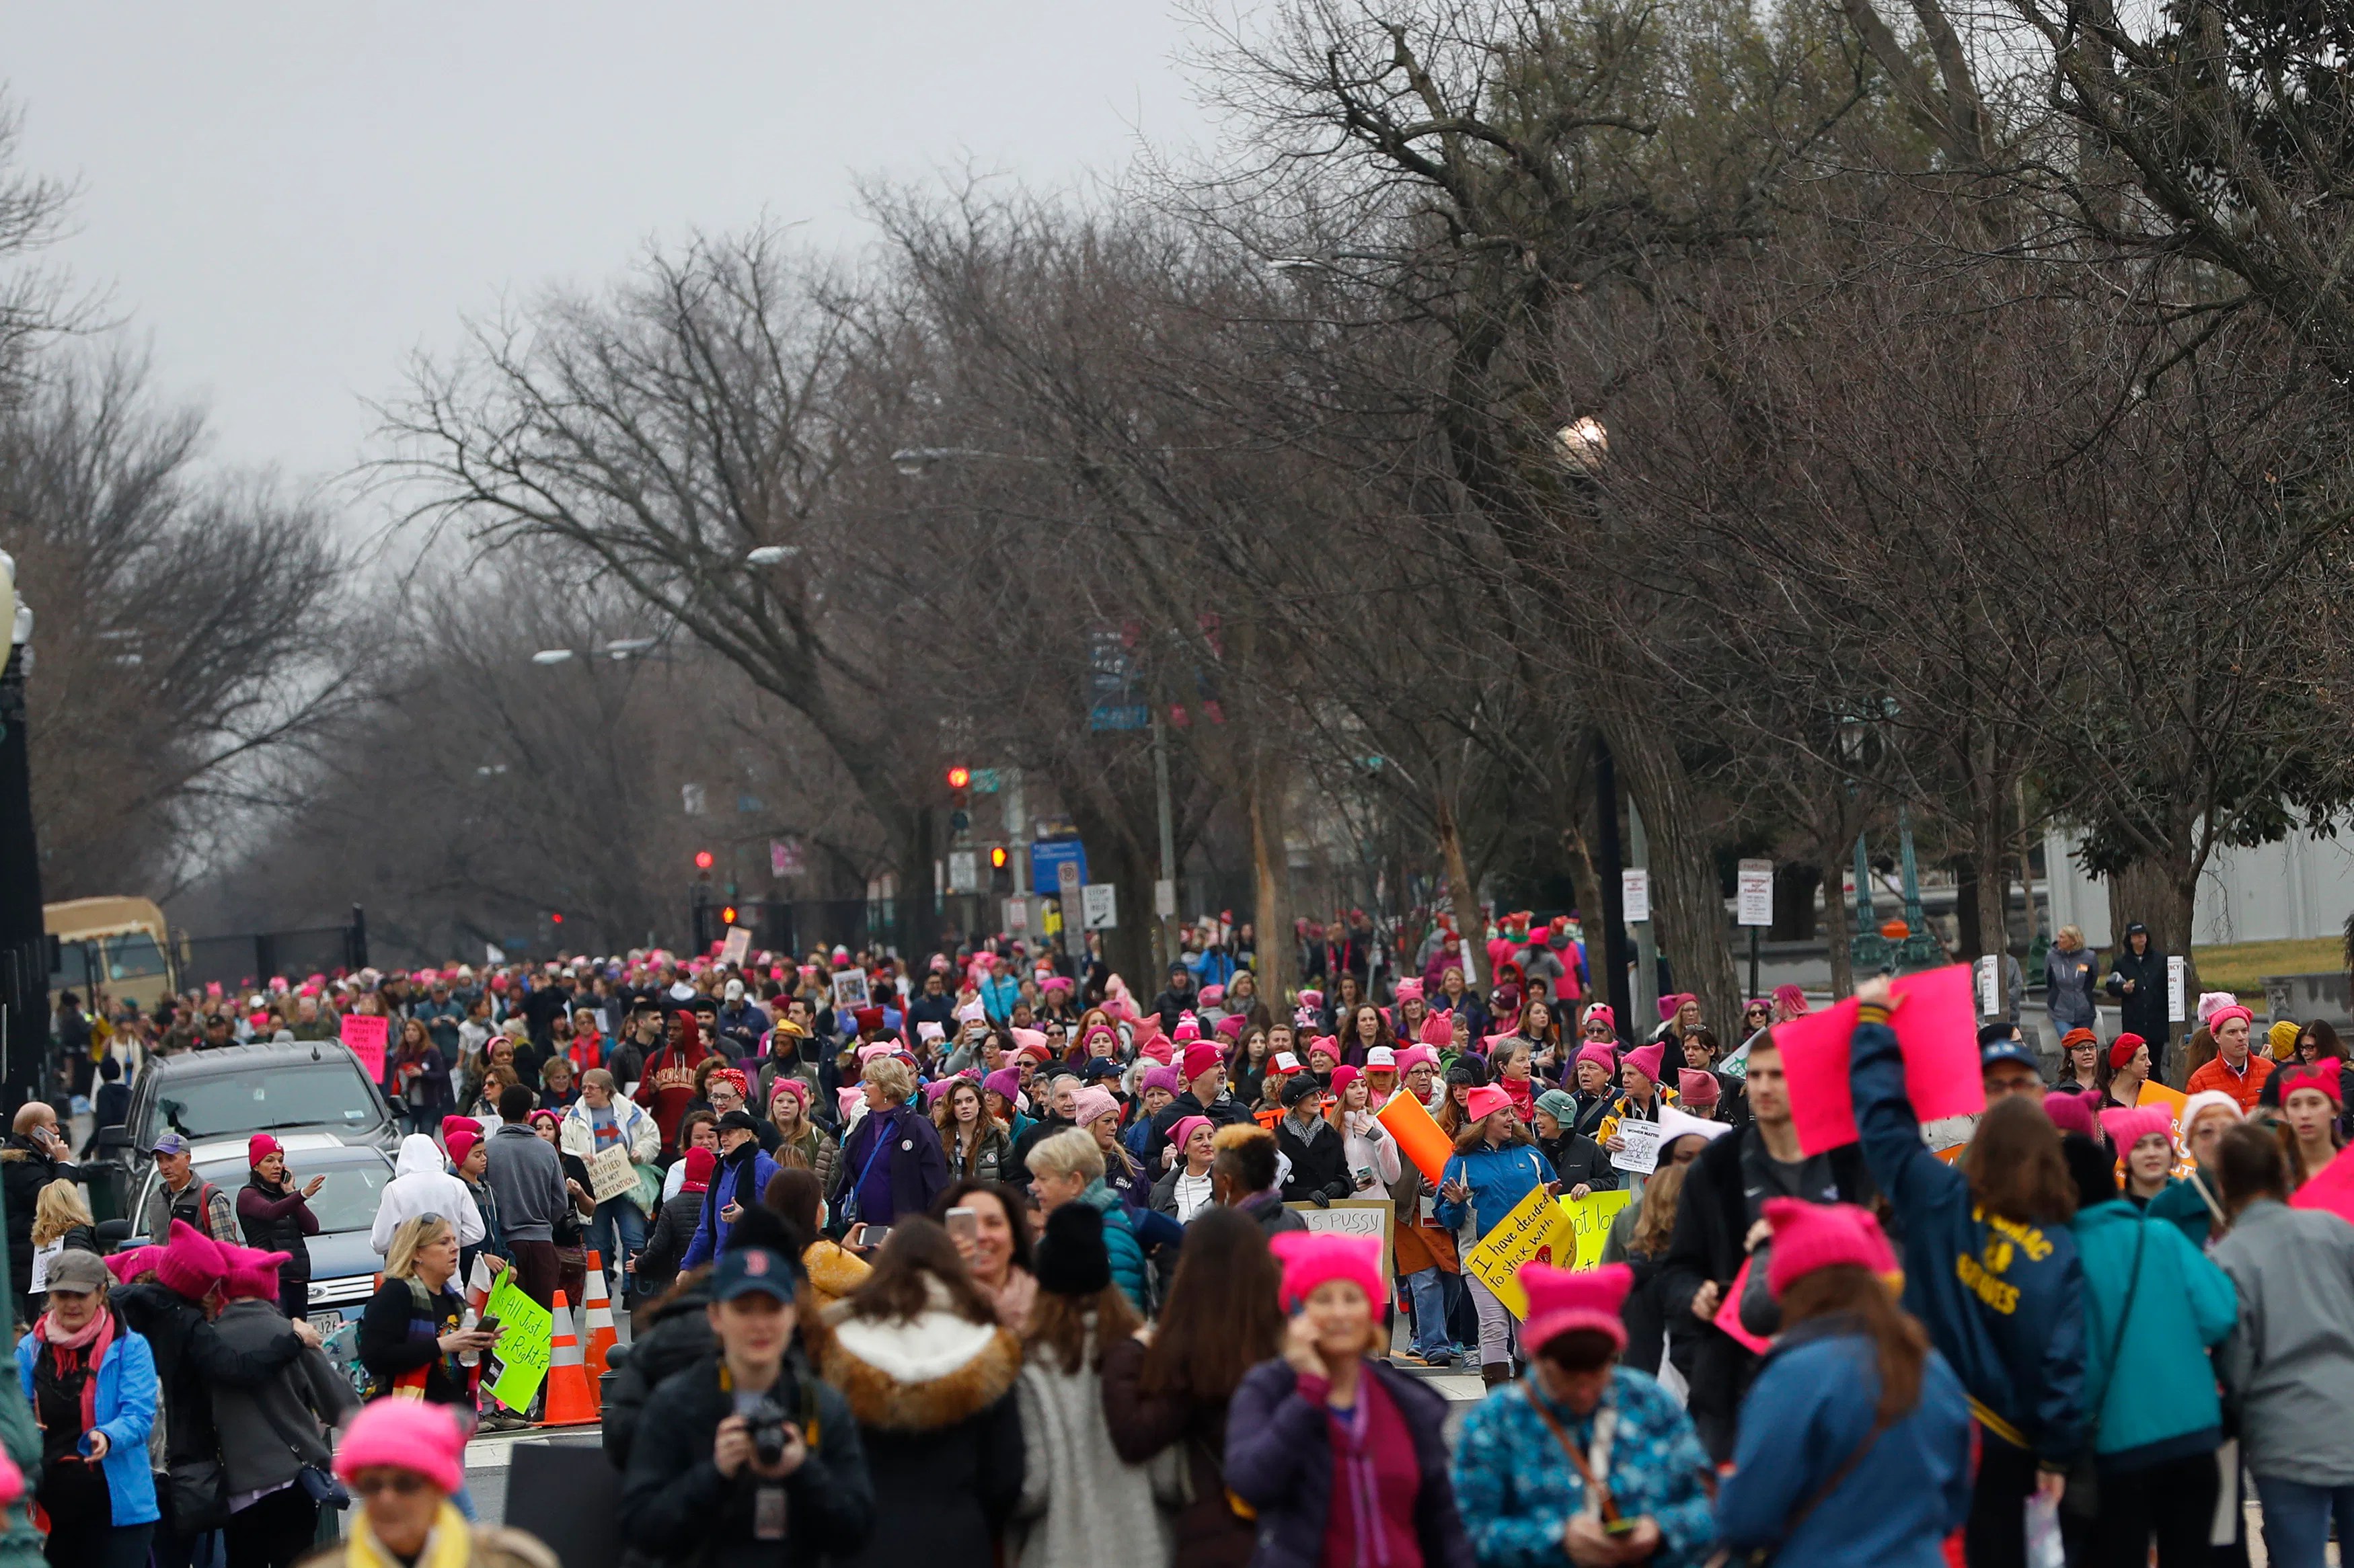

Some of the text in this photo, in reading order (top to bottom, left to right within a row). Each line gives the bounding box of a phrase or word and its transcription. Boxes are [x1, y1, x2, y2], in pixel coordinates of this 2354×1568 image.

[656, 1067, 696, 1085] REDSKI
[602, 1175, 636, 1198] ATTENTION
[1329, 1213, 1379, 1238] PUSSY
[1486, 1231, 1518, 1256] have
[1514, 1193, 1550, 1232] decided
[1574, 1206, 1591, 1236] ot
[1488, 1276, 1505, 1289] to
[1503, 1245, 1532, 1276] stick
[1529, 1218, 1554, 1245] with
[506, 1295, 523, 1321] All
[519, 1310, 543, 1337] Just
[511, 1335, 550, 1370] Right?
